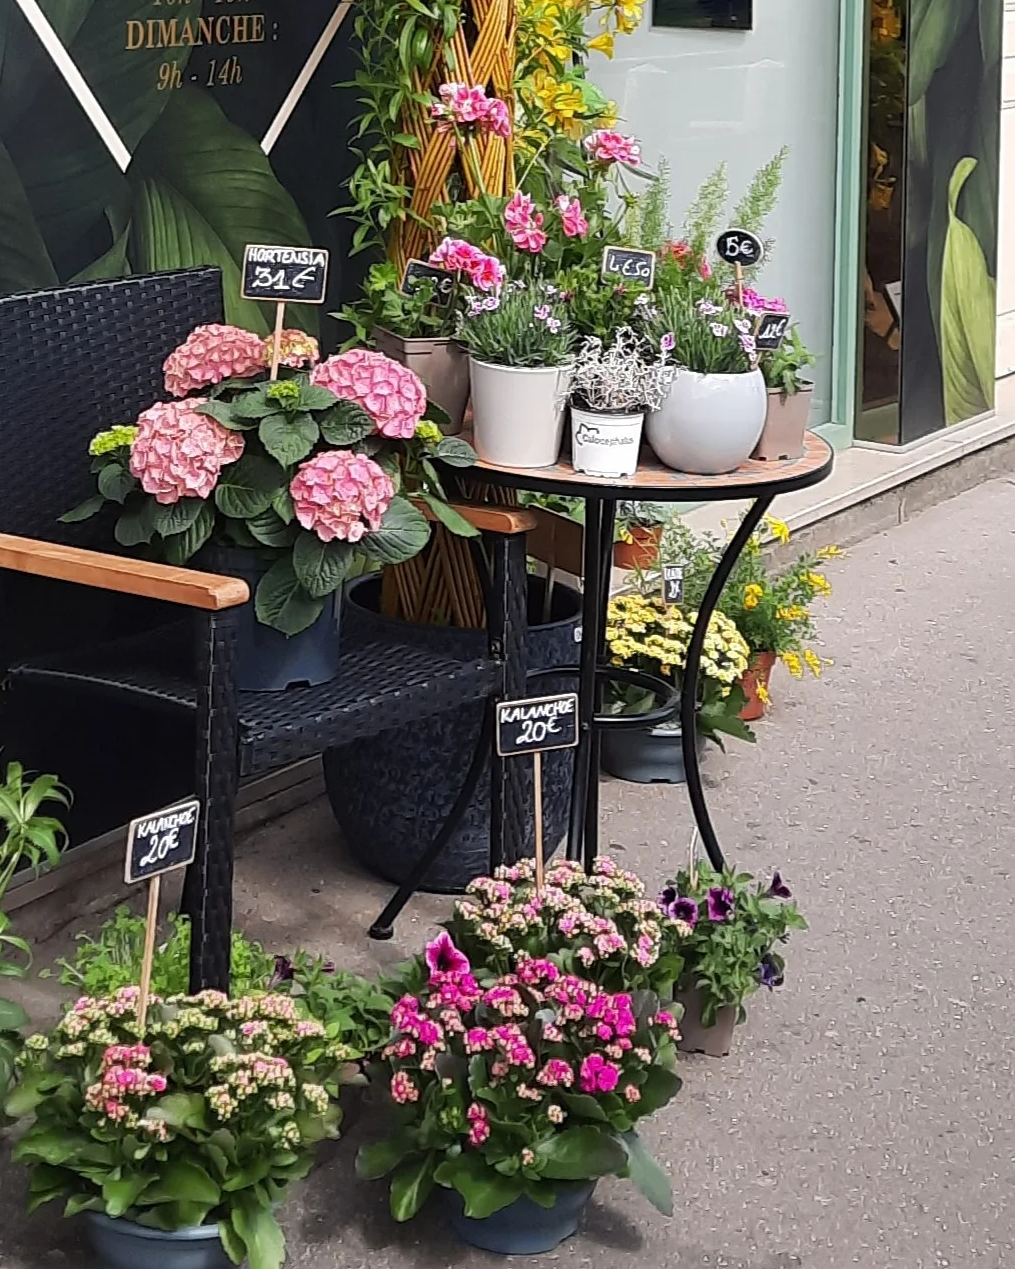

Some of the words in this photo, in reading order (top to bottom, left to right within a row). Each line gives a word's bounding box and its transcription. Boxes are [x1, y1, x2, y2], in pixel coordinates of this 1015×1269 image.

[125, 14, 265, 50] DIMANCHE
[157, 62, 183, 90] 9h
[207, 56, 243, 87] 14h
[248, 247, 325, 267] HORTENSIA
[725, 236, 754, 258] 5€
[500, 698, 575, 723] KALANCHOE
[516, 716, 562, 744] 20€
[139, 828, 179, 867] 20€
